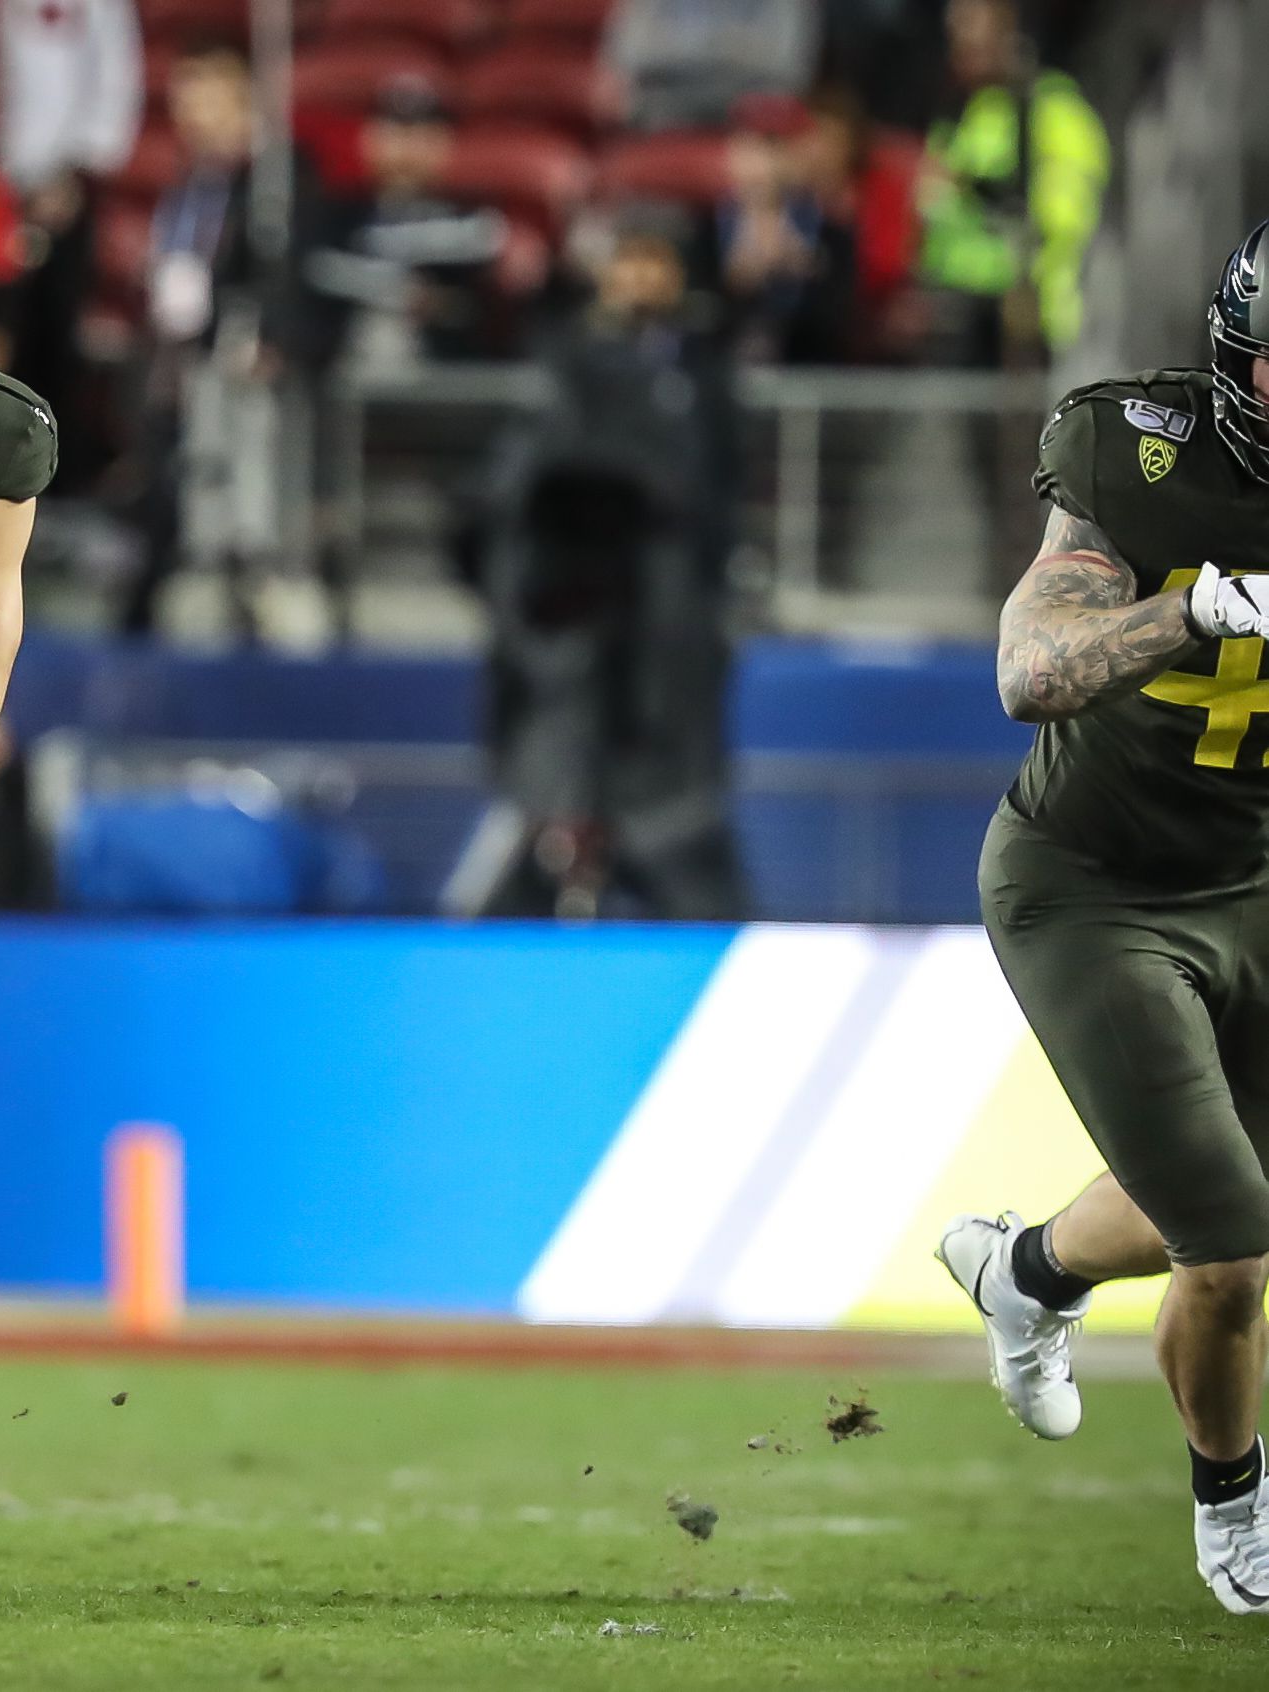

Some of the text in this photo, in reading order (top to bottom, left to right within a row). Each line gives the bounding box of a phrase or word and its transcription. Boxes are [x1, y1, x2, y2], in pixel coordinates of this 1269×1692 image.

[1119, 399, 1196, 441] 150
[1145, 454, 1165, 475] 12
[1140, 568, 1269, 769] 4
